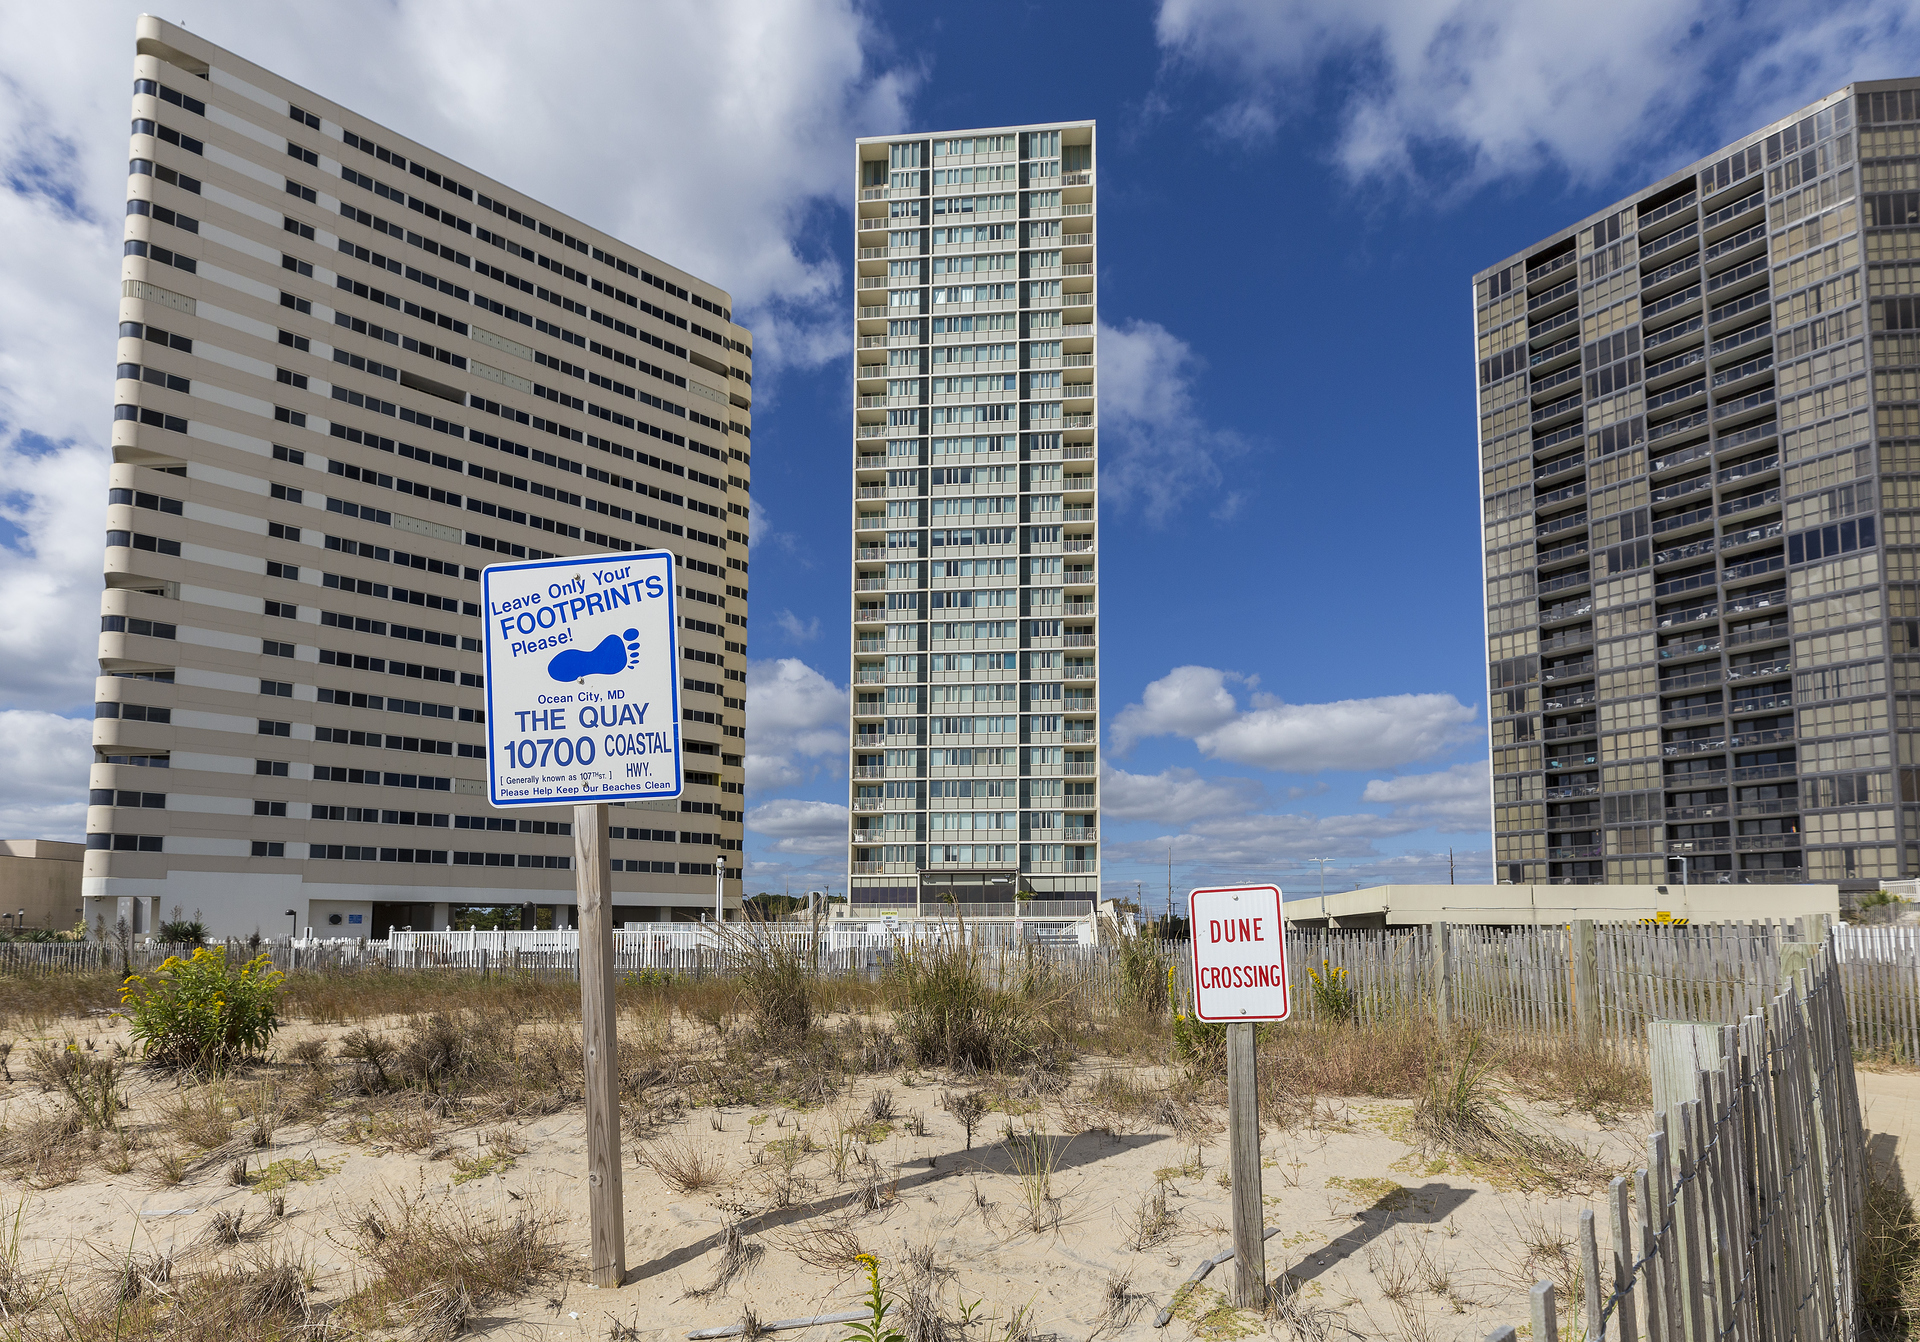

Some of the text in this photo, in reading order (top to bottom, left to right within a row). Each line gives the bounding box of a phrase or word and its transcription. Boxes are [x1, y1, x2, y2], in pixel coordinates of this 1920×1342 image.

[491, 566, 631, 616] Leave Only Your
[500, 575, 664, 640] FOOTPRINTS
[511, 627, 573, 657] Please!
[537, 689, 625, 705] Ocean City, MD
[514, 702, 649, 732] THE QUAY
[503, 731, 672, 769] 10700 COASTAL
[506, 775, 540, 785] Generally
[541, 774, 566, 782] known
[626, 762, 652, 777] HWY.
[500, 781, 671, 797] Please Help Keep Our Beaches Clean
[1210, 917, 1265, 943] DUNE
[1200, 964, 1281, 989] CROSSING
